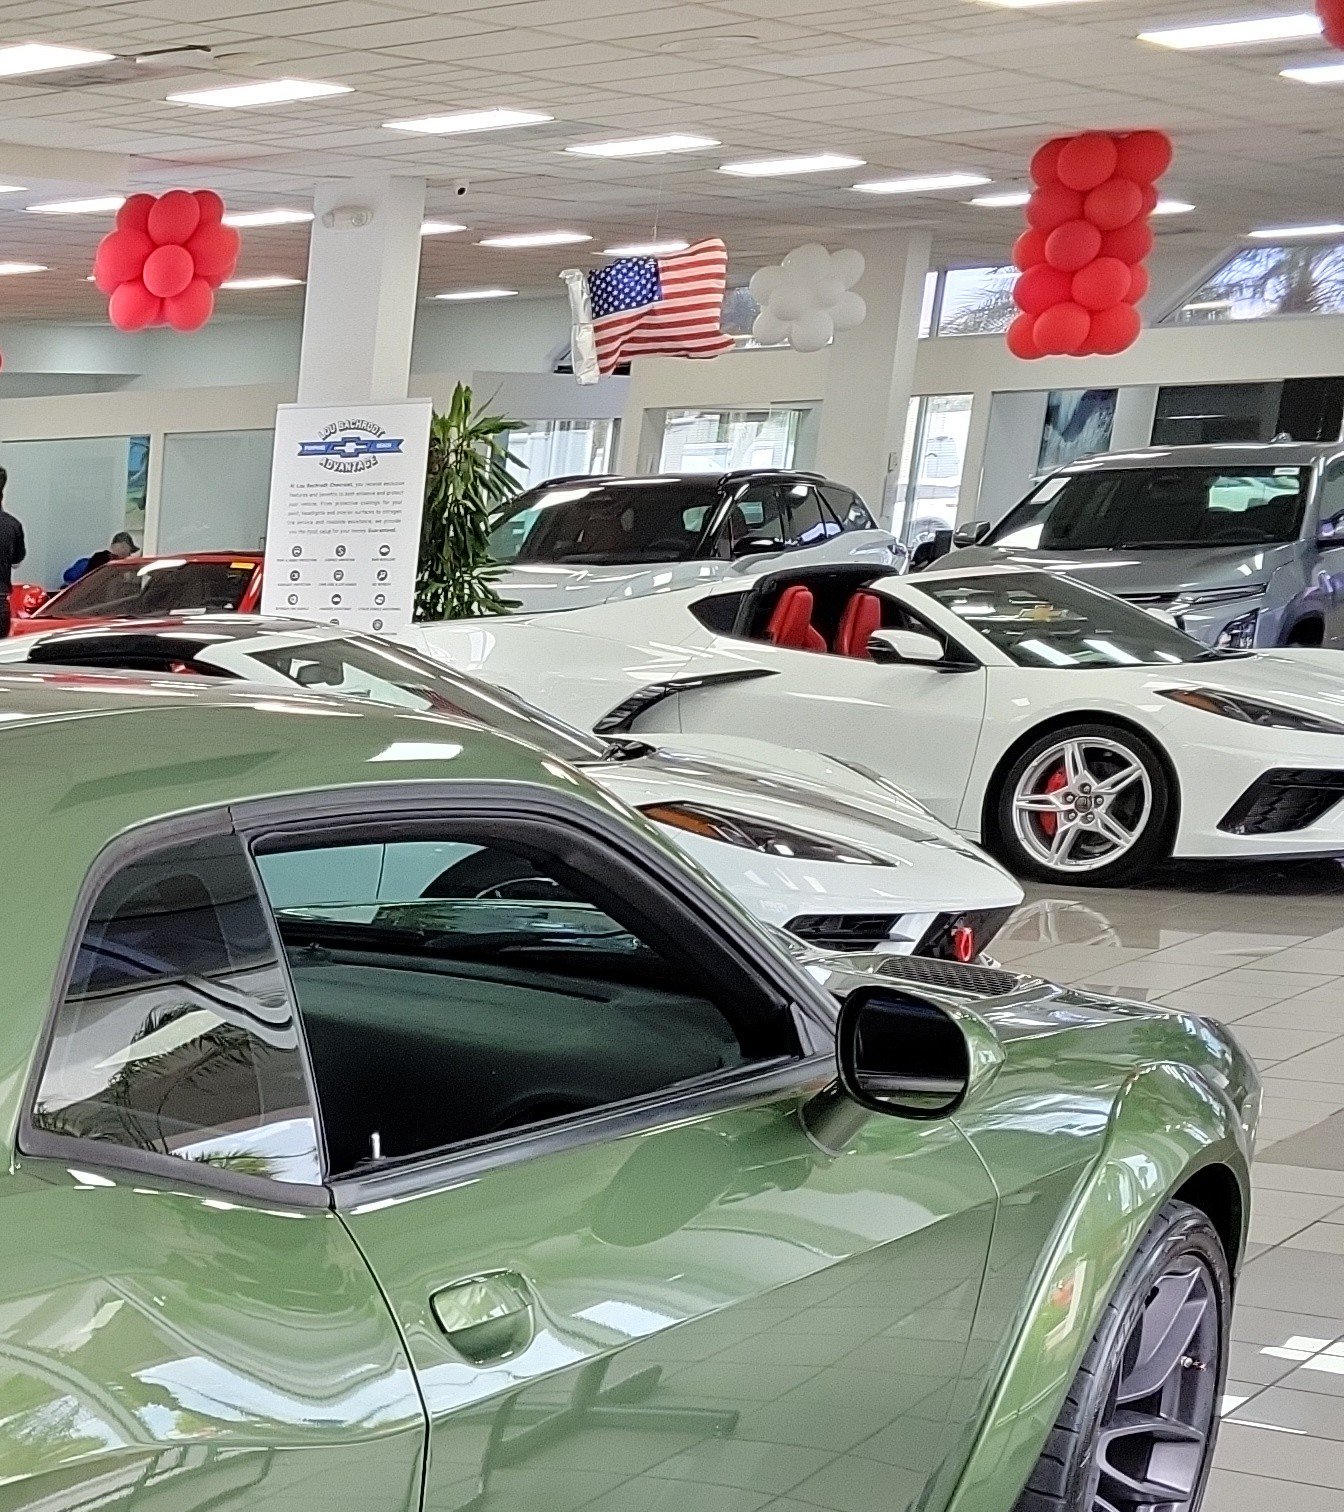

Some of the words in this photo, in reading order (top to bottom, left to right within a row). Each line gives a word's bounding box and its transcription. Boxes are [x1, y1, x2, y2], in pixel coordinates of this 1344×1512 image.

[317, 422, 338, 441] LOU
[338, 418, 387, 438] BACHRODT
[319, 455, 379, 473] ADVANTAGE
